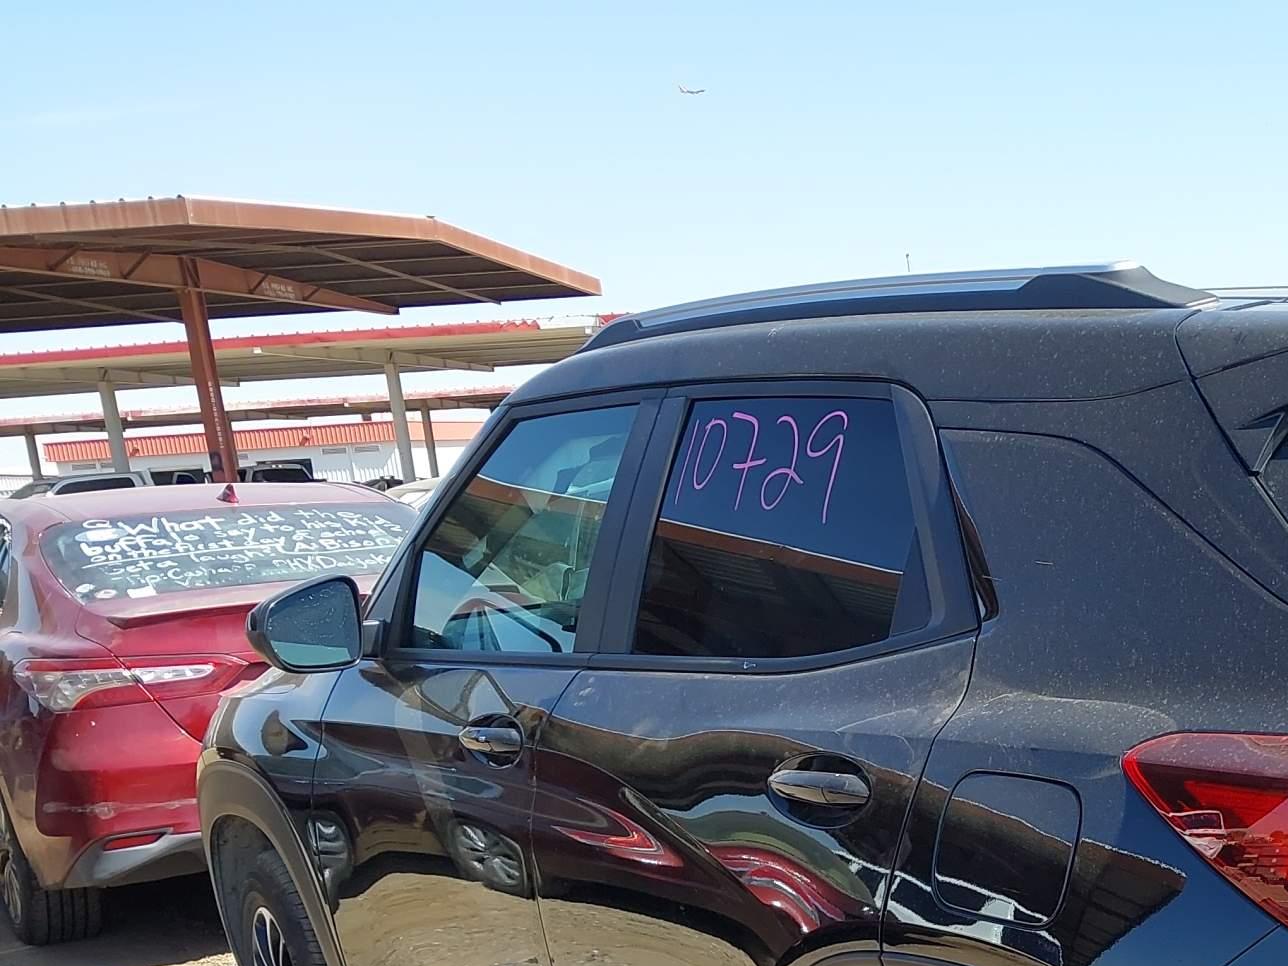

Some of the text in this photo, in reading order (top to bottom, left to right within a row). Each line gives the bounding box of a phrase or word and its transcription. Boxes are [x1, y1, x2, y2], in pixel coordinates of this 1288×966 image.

[674, 410, 848, 524] 10729
[238, 511, 285, 525] did
[293, 509, 362, 519] the
[80, 531, 200, 557] buffalo
[214, 527, 256, 541] say
[260, 523, 294, 532] to
